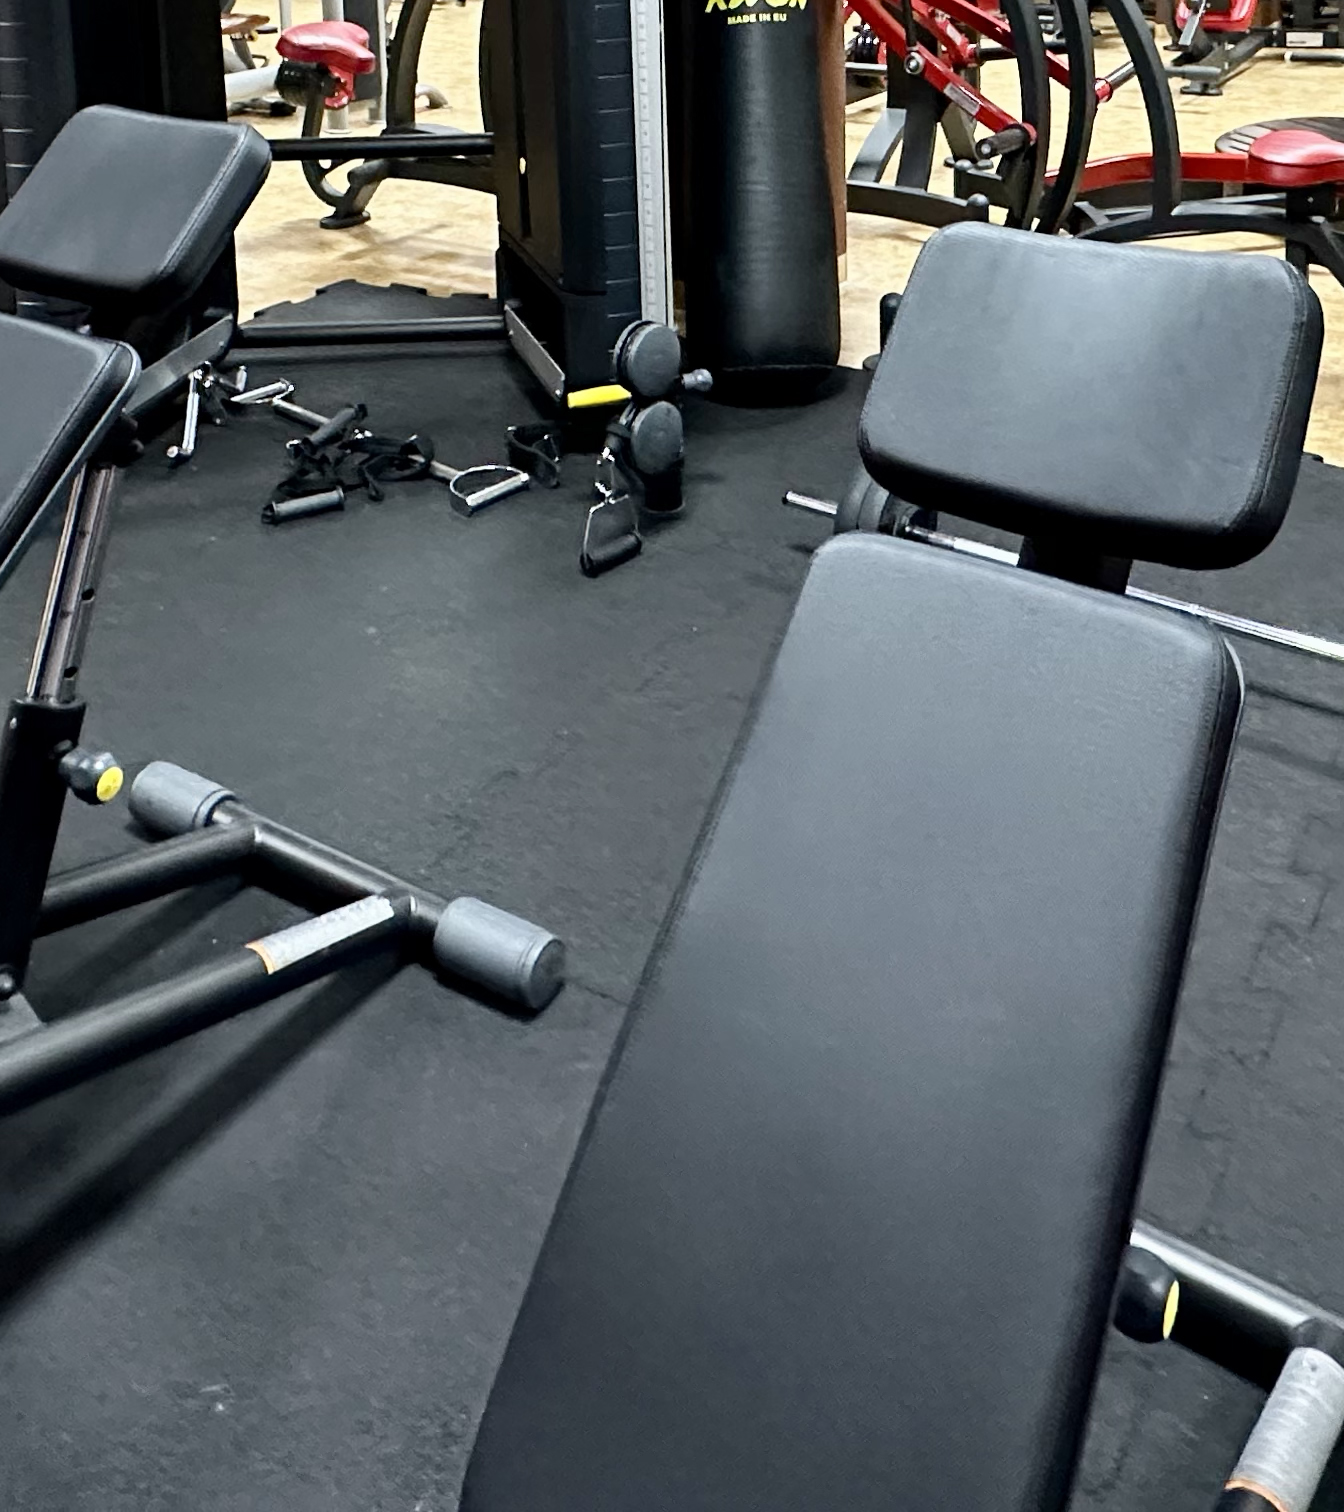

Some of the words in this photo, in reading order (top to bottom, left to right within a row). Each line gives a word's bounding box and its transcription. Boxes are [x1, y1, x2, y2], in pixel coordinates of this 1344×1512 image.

[727, 13, 757, 25] MADE
[758, 13, 771, 23] IN
[772, 12, 787, 22] EU
